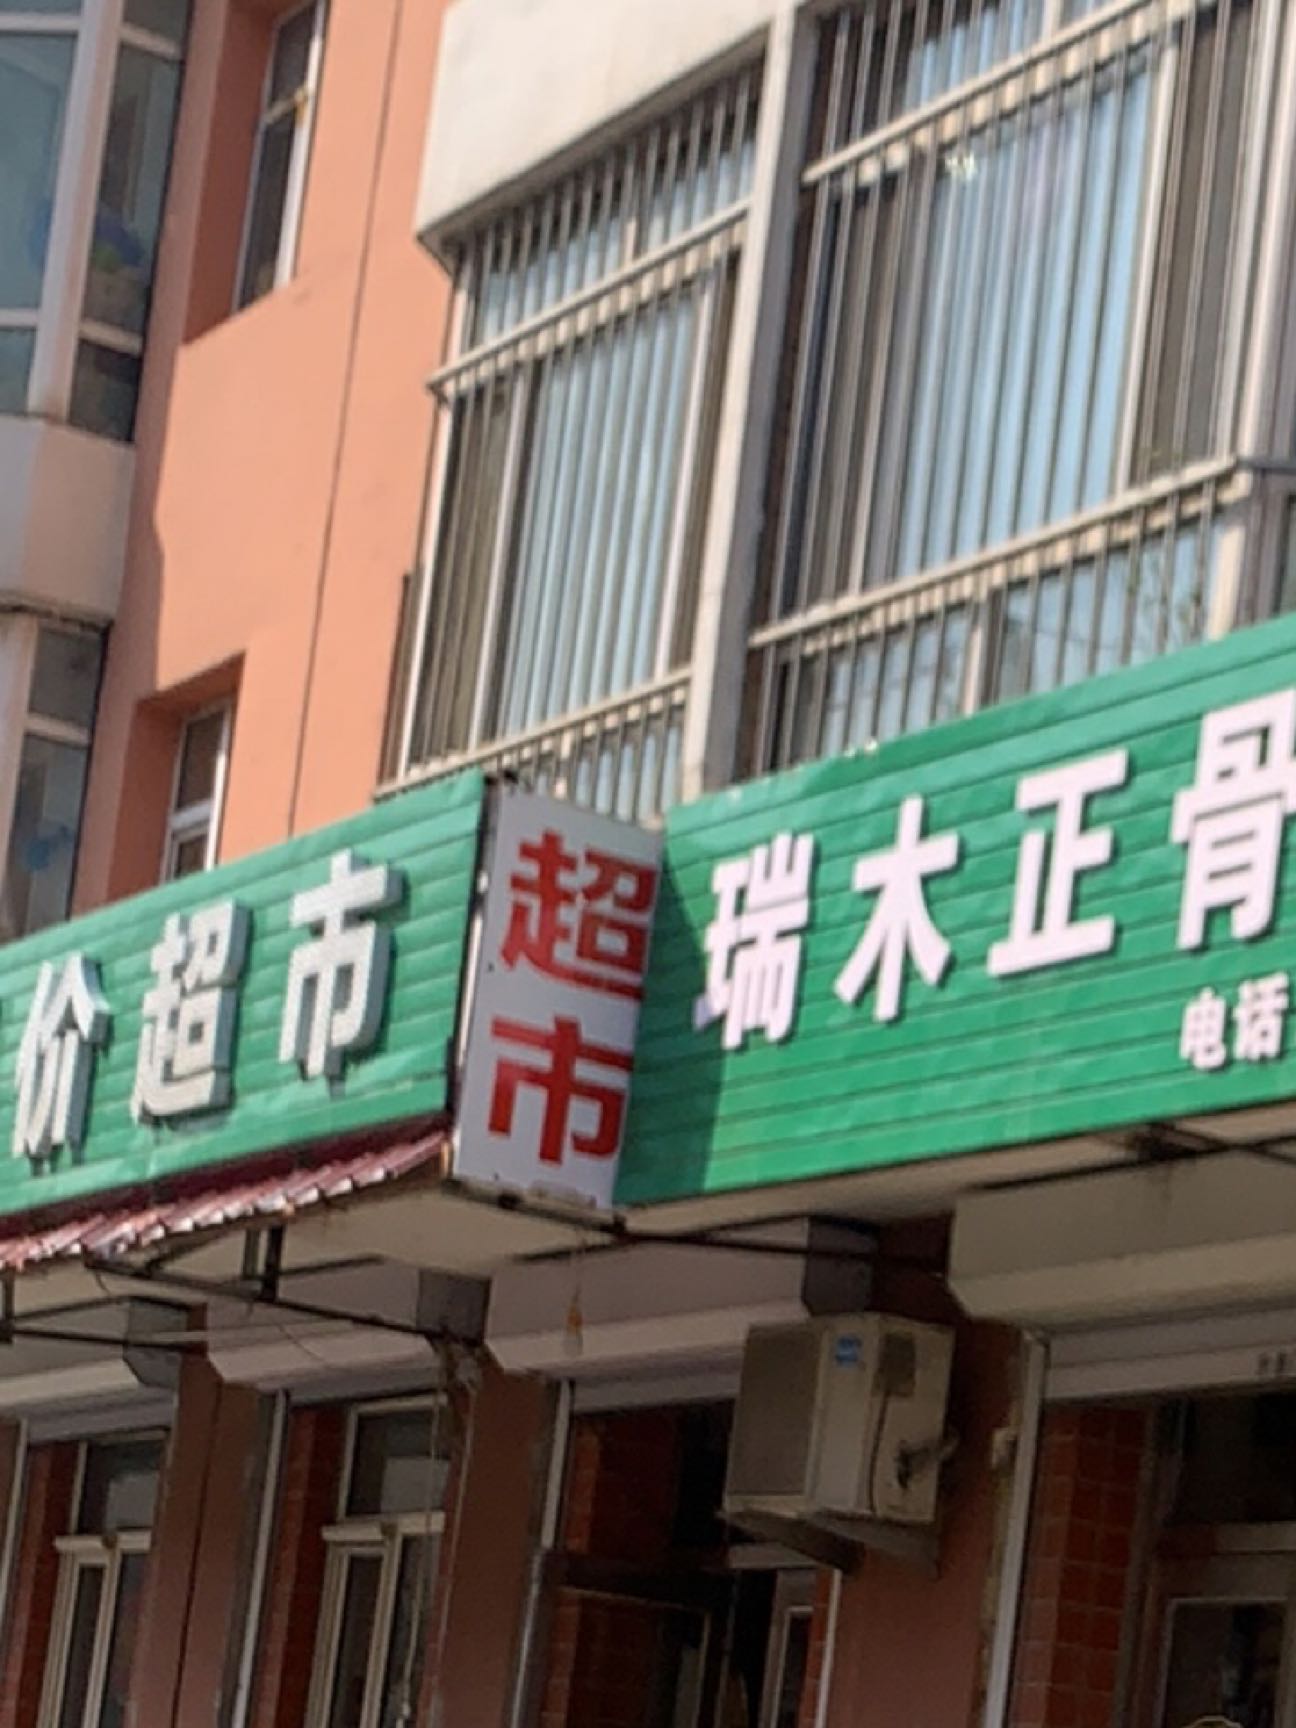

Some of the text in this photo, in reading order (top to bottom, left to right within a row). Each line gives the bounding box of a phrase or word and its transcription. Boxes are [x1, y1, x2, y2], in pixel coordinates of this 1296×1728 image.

[11, 847, 403, 1158] 价超市
[488, 829, 657, 1166] 超市
